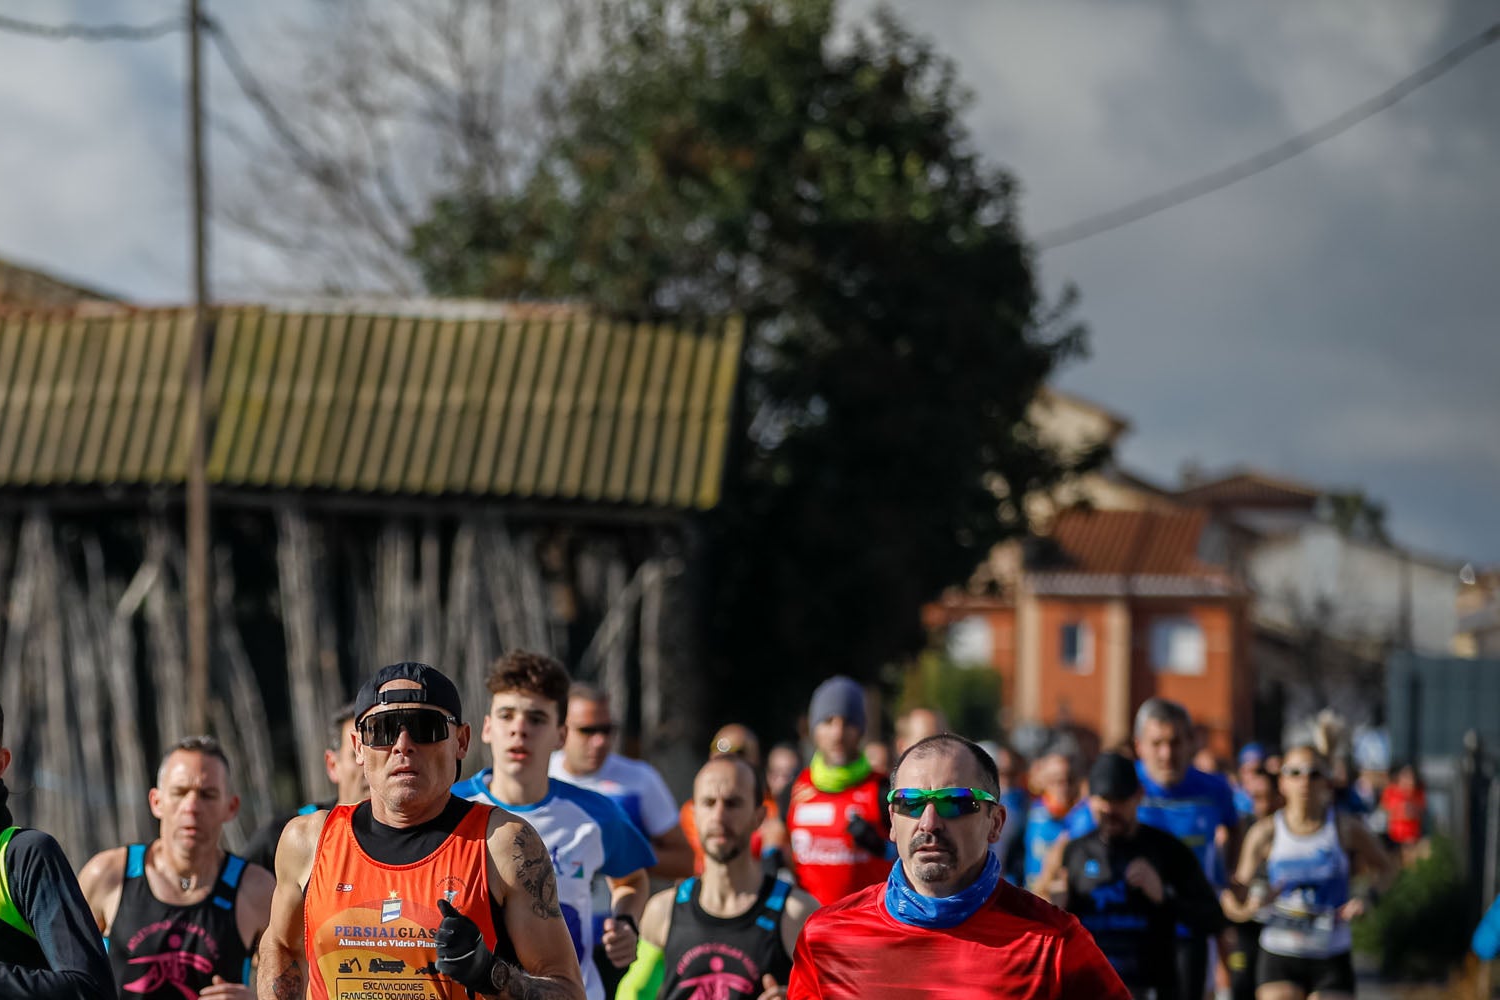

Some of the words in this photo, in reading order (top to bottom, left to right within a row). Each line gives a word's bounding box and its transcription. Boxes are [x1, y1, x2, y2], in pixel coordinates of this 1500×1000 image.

[377, 939, 388, 947] de
[389, 940, 415, 948] Vidrio
[363, 982, 424, 991] EXCAVACIONES
[341, 992, 384, 1000] FRANCISCO
